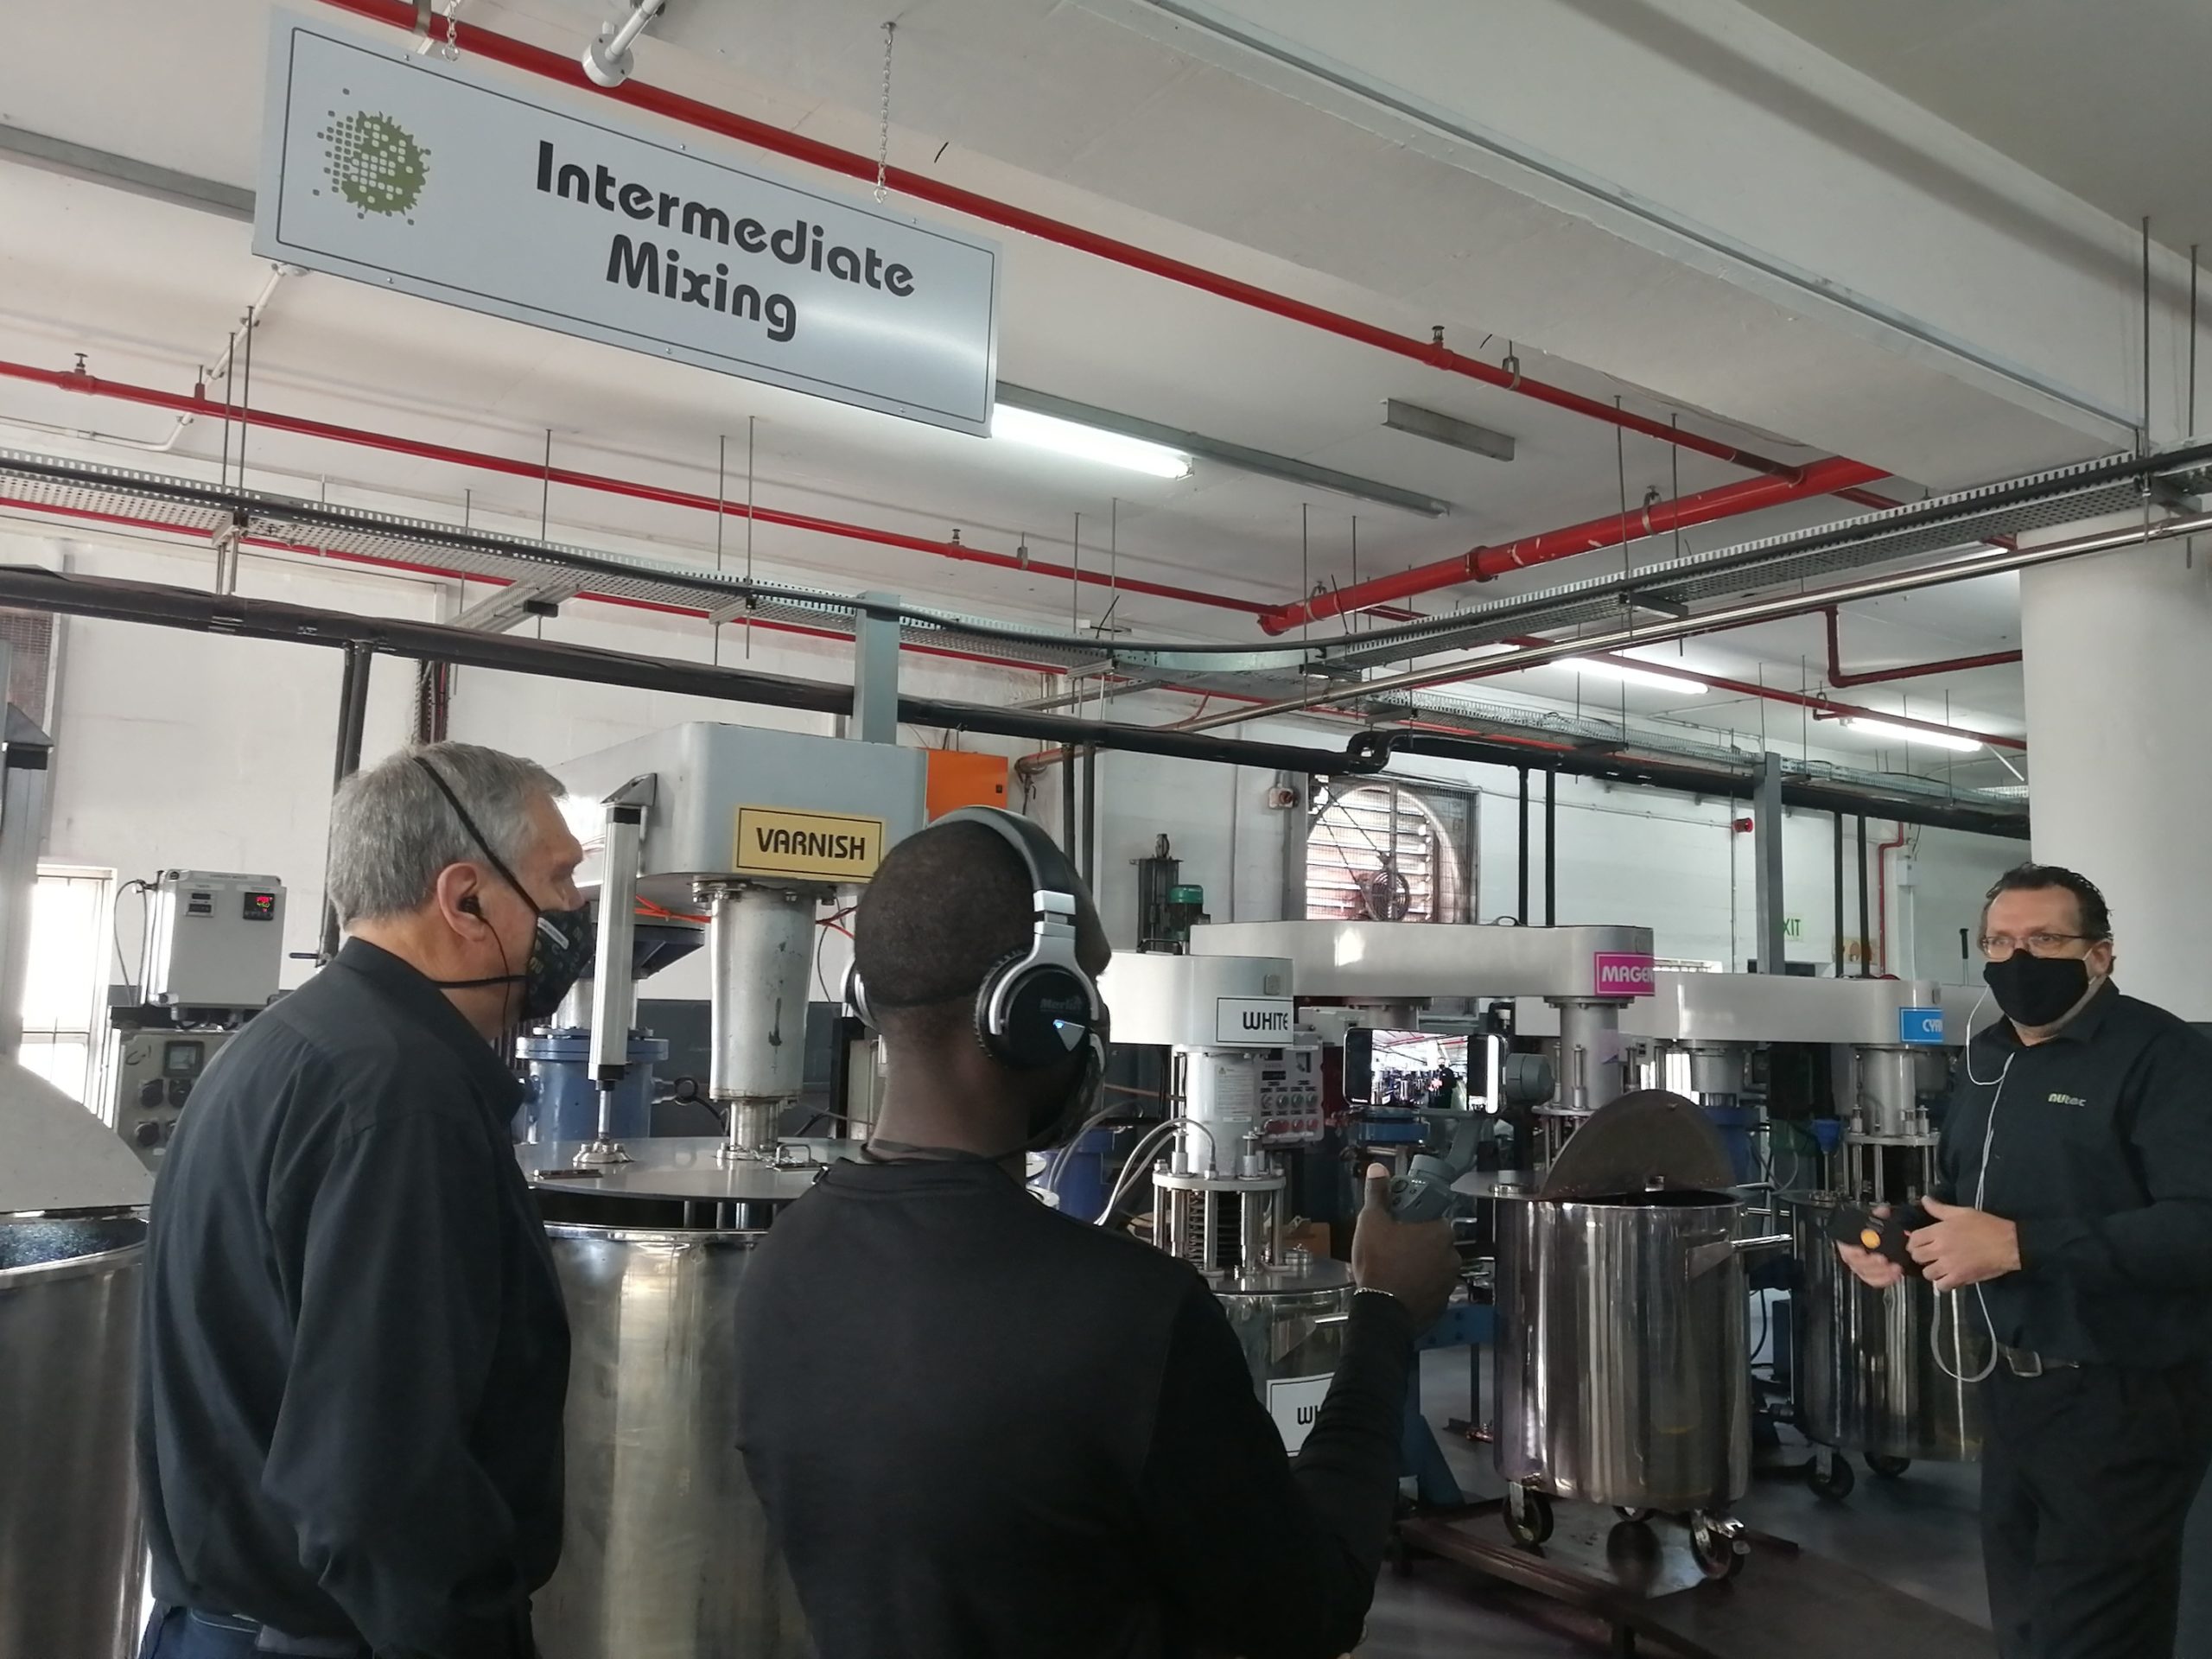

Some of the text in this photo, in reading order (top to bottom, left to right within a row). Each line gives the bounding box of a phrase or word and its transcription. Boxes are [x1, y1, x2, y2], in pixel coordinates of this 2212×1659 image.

[537, 140, 916, 298] Intermediate
[607, 234, 797, 343] Mixing
[756, 827, 866, 861] VARNISH
[1783, 918, 1802, 937] XIT
[1243, 1011, 1288, 1031] WHITE
[1923, 1019, 1943, 1033] CYA
